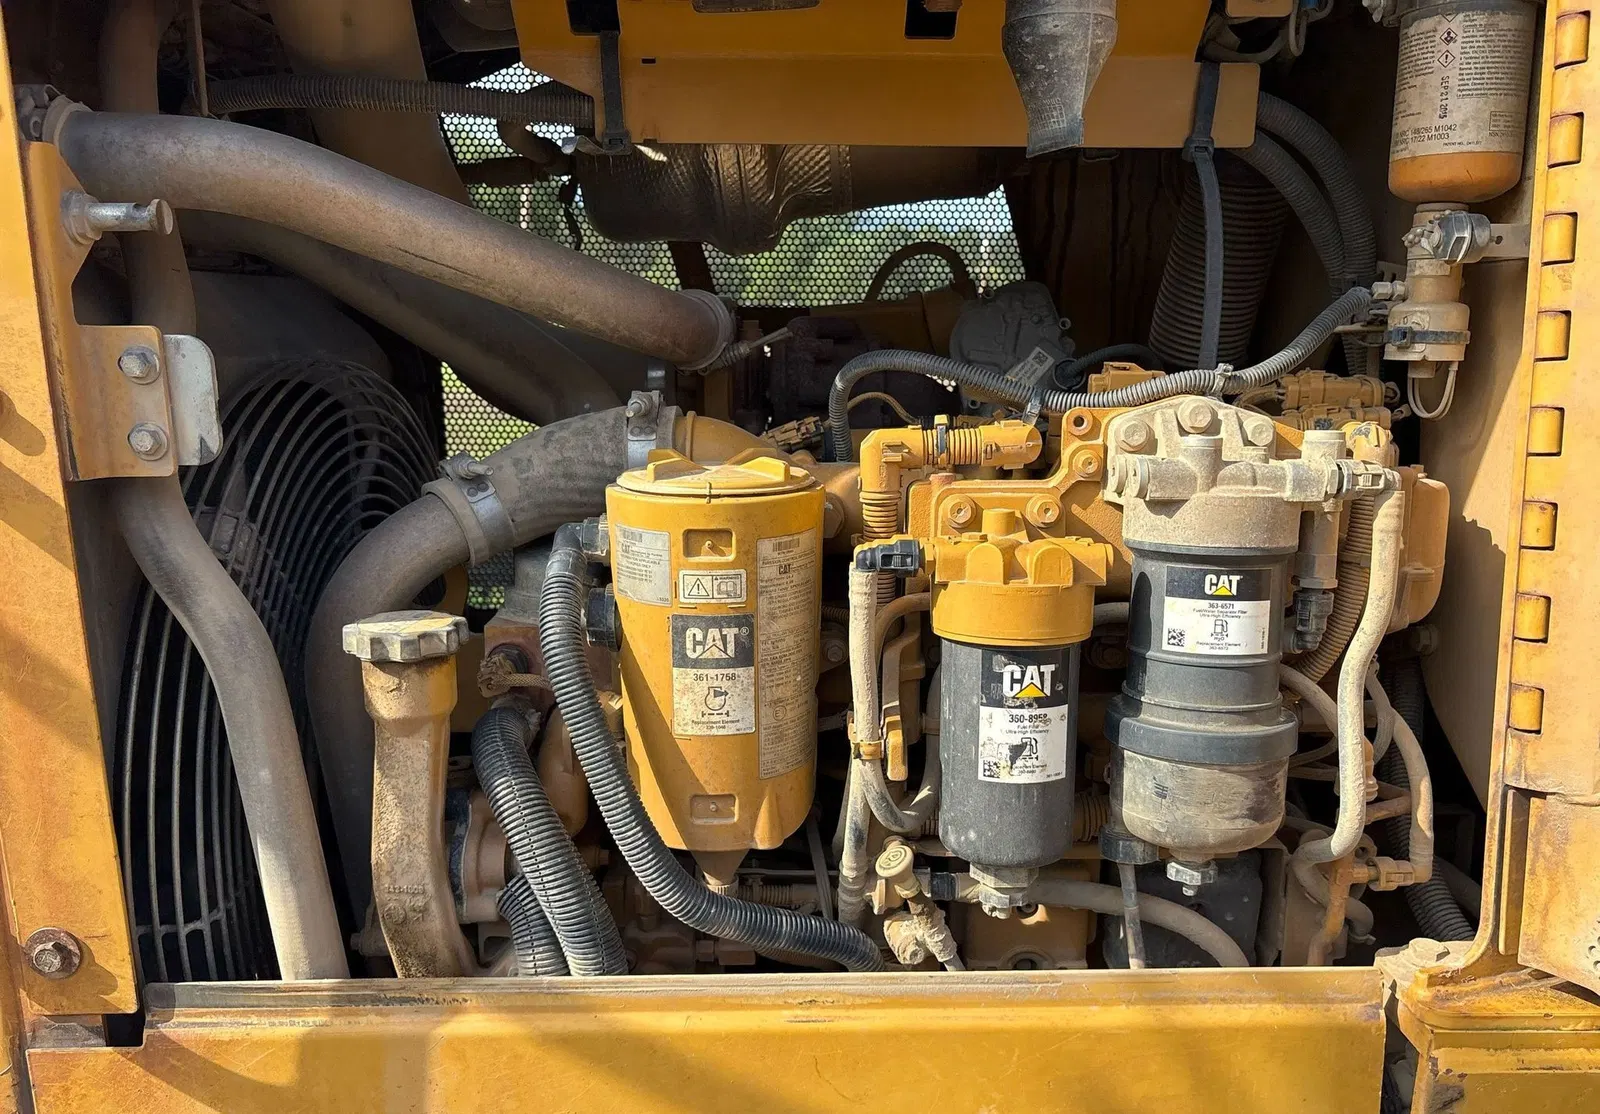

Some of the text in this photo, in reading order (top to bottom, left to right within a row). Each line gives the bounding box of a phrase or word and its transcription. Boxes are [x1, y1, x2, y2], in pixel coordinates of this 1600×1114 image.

[1440, 75, 1450, 91] SEP
[1439, 91, 1449, 103] 21
[1433, 123, 1458, 133] M1042
[1410, 135, 1426, 143] 17/22
[1426, 132, 1450, 142] M1003
[778, 563, 791, 575] CAT
[1204, 574, 1241, 596] CAT
[693, 672, 737, 682] 361-1758
[1002, 664, 1056, 698] CAT
